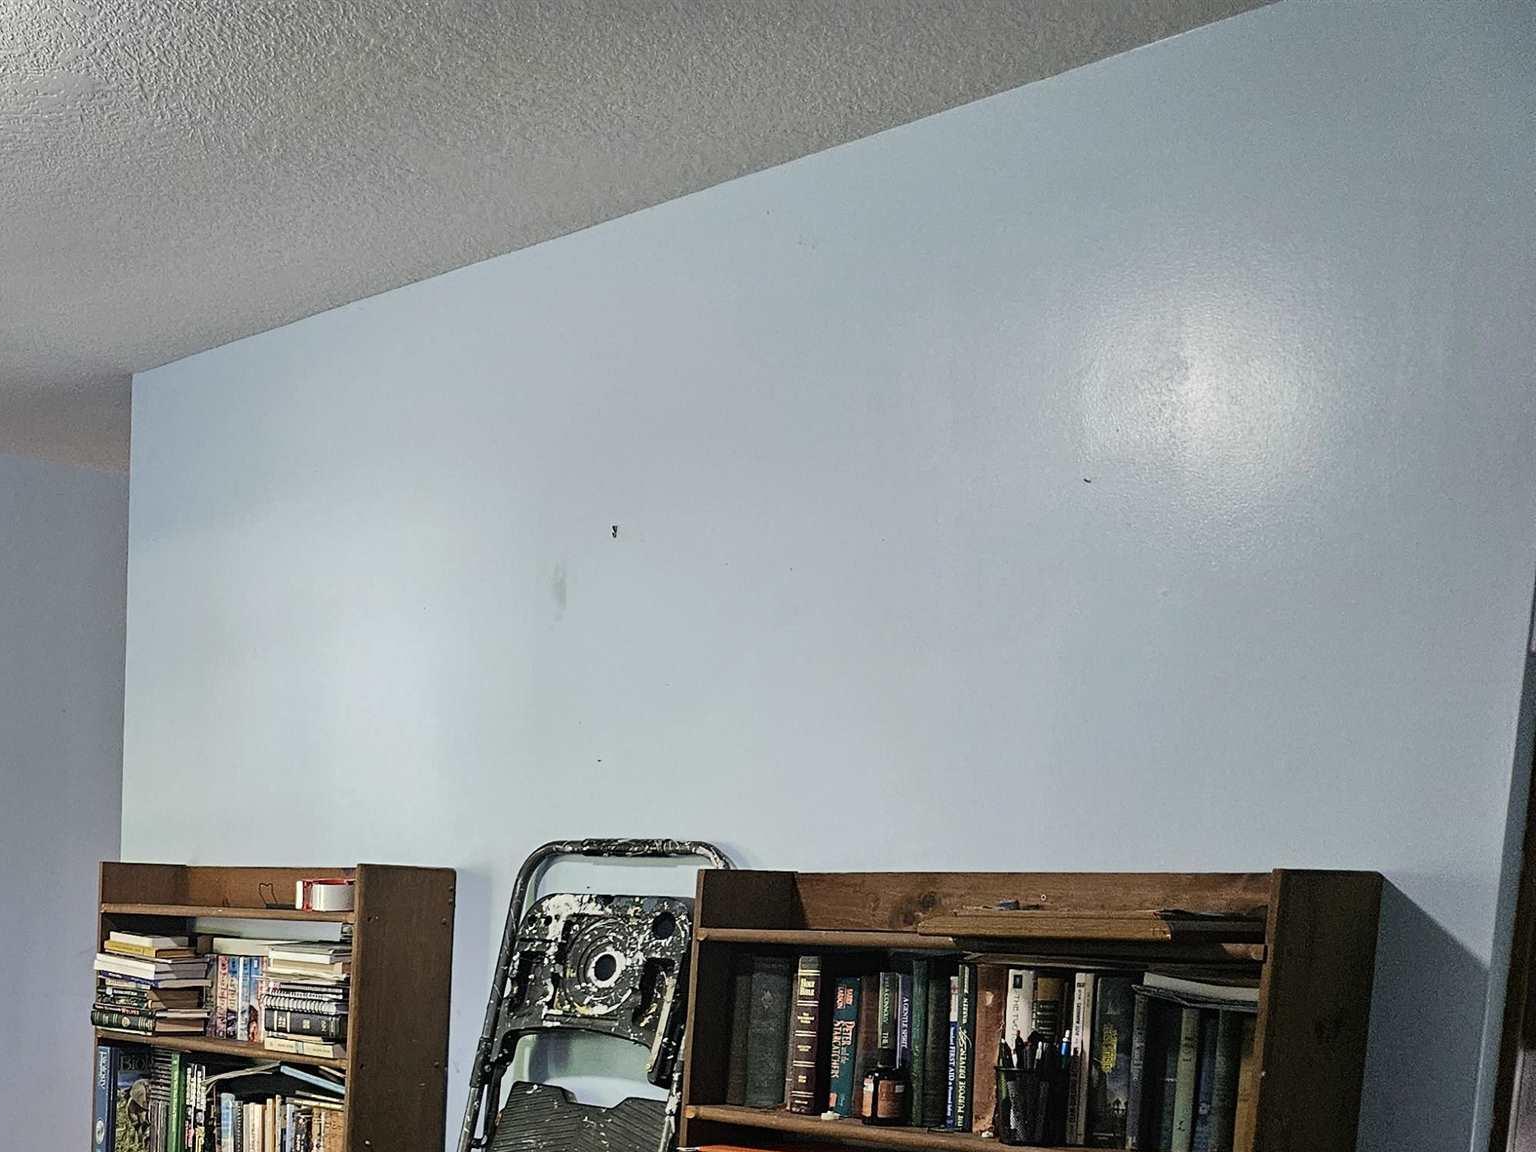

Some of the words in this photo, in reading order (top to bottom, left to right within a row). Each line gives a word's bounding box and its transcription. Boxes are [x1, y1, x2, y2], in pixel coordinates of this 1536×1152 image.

[841, 1020, 855, 1046] PETER
[119, 1054, 153, 1073] Biol
[829, 1019, 844, 1079] STARCATCHERS
[948, 1045, 956, 1066] FIRST
[958, 1048, 967, 1080] DRIVEN
[957, 1081, 966, 1114] PURPOSE
